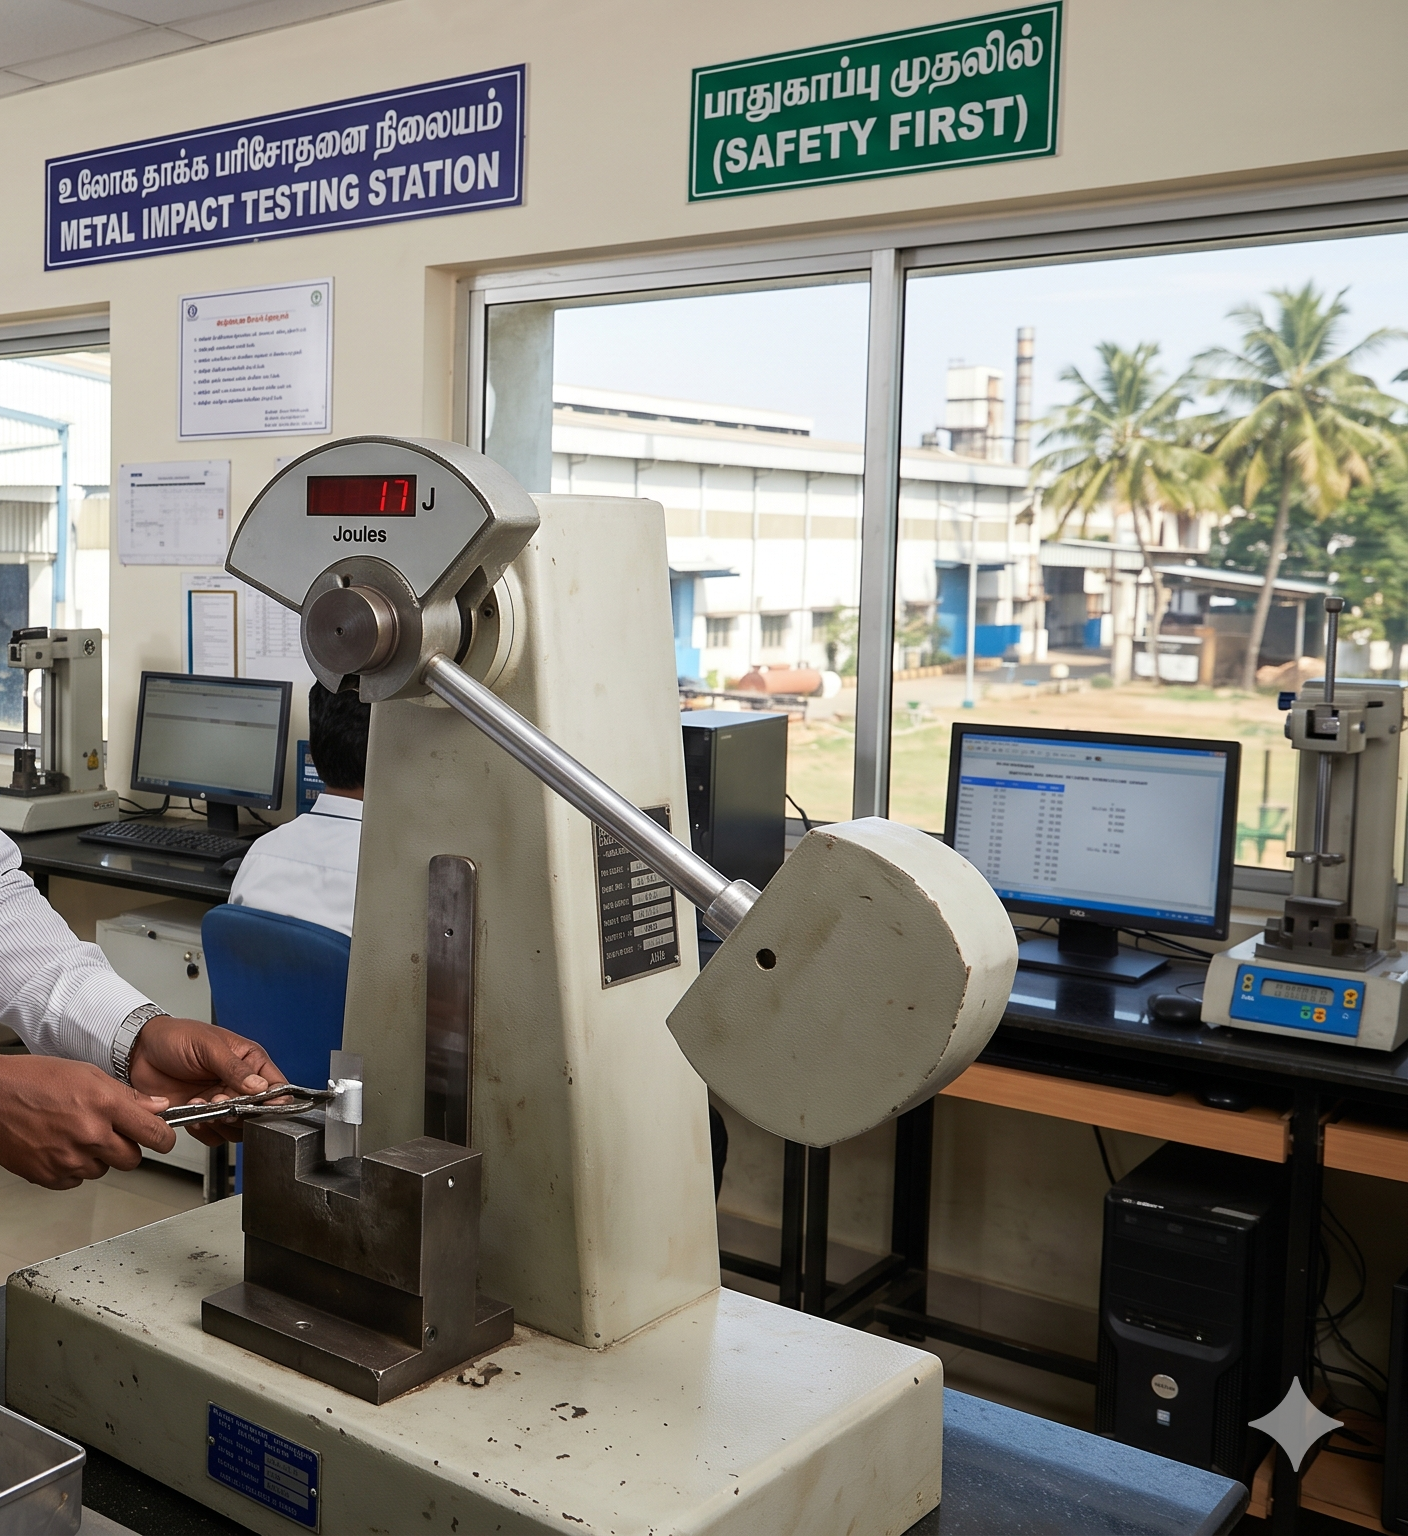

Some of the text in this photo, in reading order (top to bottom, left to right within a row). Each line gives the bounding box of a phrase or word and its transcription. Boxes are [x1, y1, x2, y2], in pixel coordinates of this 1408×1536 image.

[704, 24, 1044, 122] பாதுகாப்பு முதலில்
[58, 87, 503, 204] உலோக தாக்க பரிசோதனை நிலையம்
[713, 95, 1028, 185] (SAFETY FIRST)
[60, 150, 500, 252] METAL IMPACT TESTING STATION
[332, 525, 388, 543] Joules
[379, 479, 436, 512] 17 J
